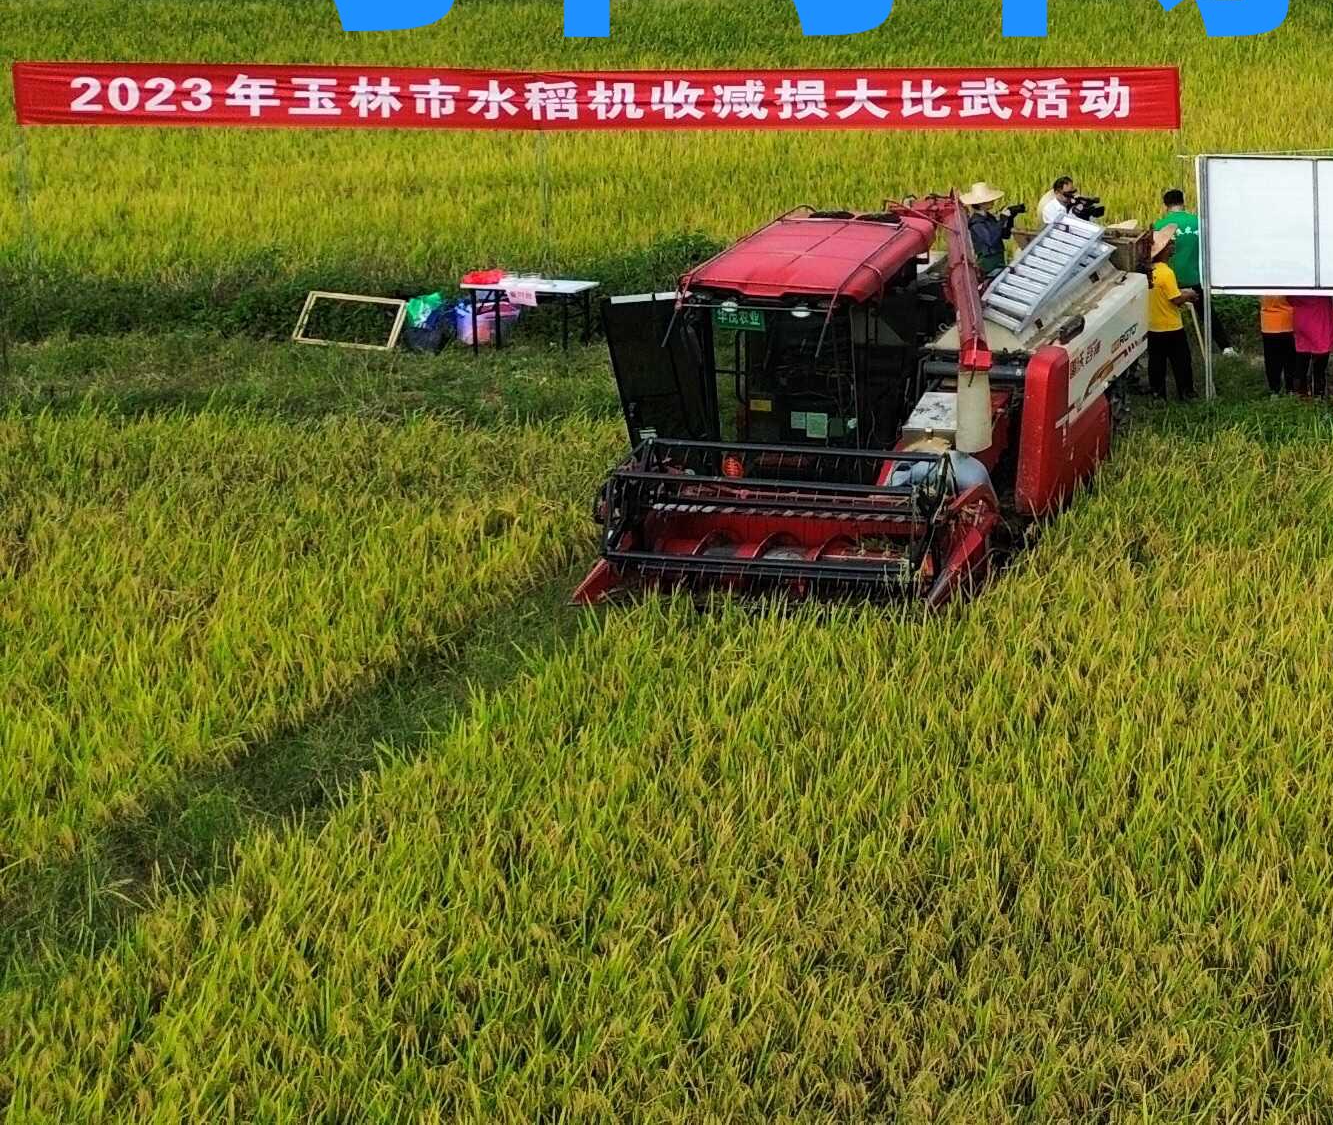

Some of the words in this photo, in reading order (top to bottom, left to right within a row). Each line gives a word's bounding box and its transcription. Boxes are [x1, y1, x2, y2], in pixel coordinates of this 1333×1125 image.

[70, 74, 1130, 120] 2023年玉林市水稻机收减损大比武活动
